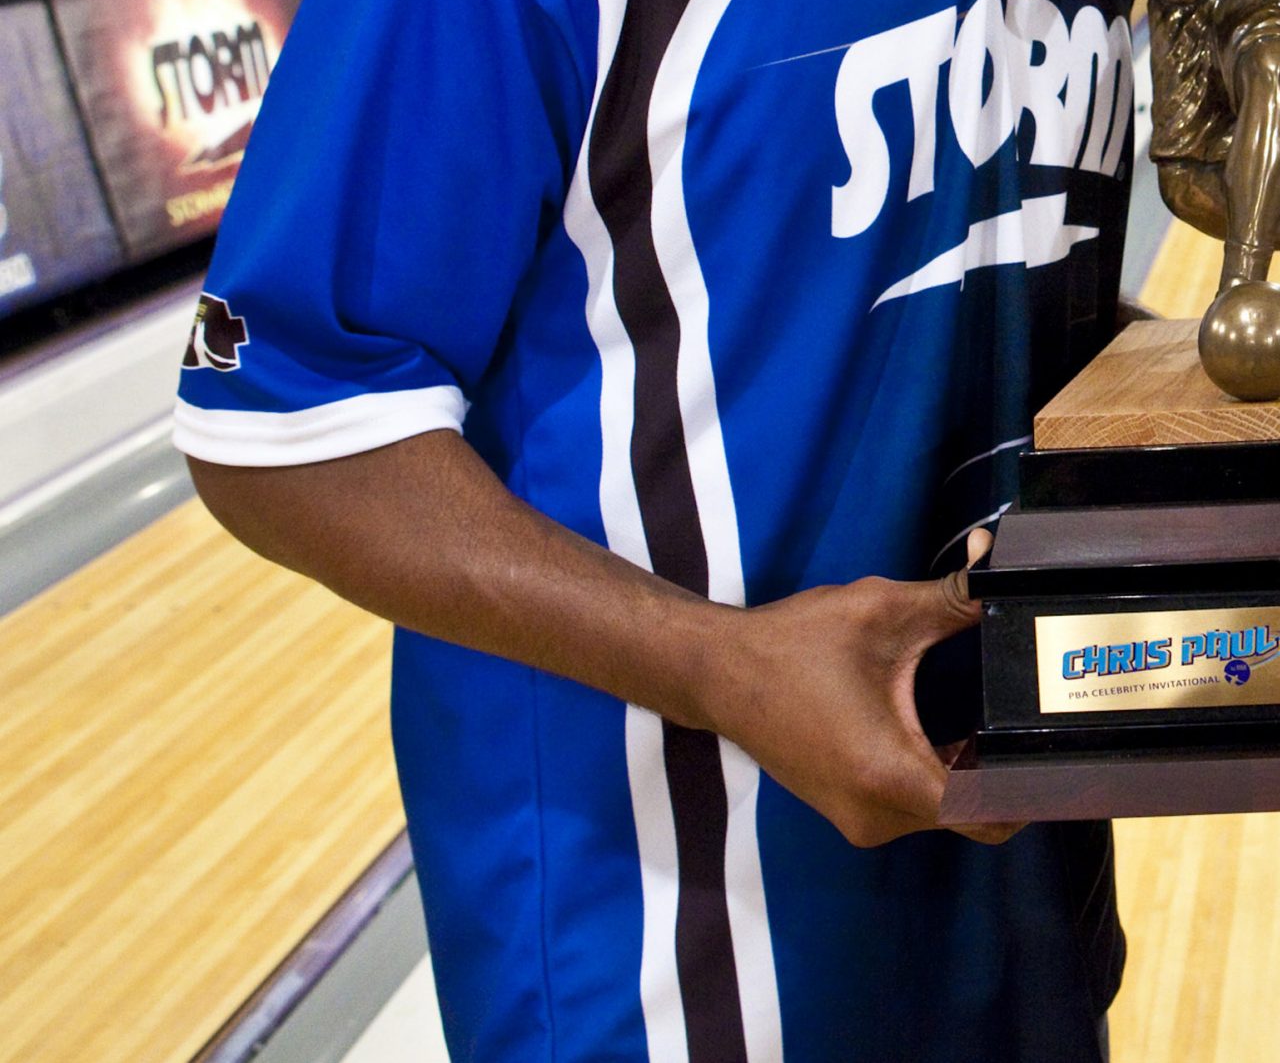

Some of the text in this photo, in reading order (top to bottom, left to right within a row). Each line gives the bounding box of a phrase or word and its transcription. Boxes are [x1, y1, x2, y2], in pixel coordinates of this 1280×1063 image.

[152, 20, 271, 130] STORM
[1062, 625, 1279, 681] CHRIS PAUL
[1068, 675, 1221, 700] PBA CELEBRITY INVITATIONAL
